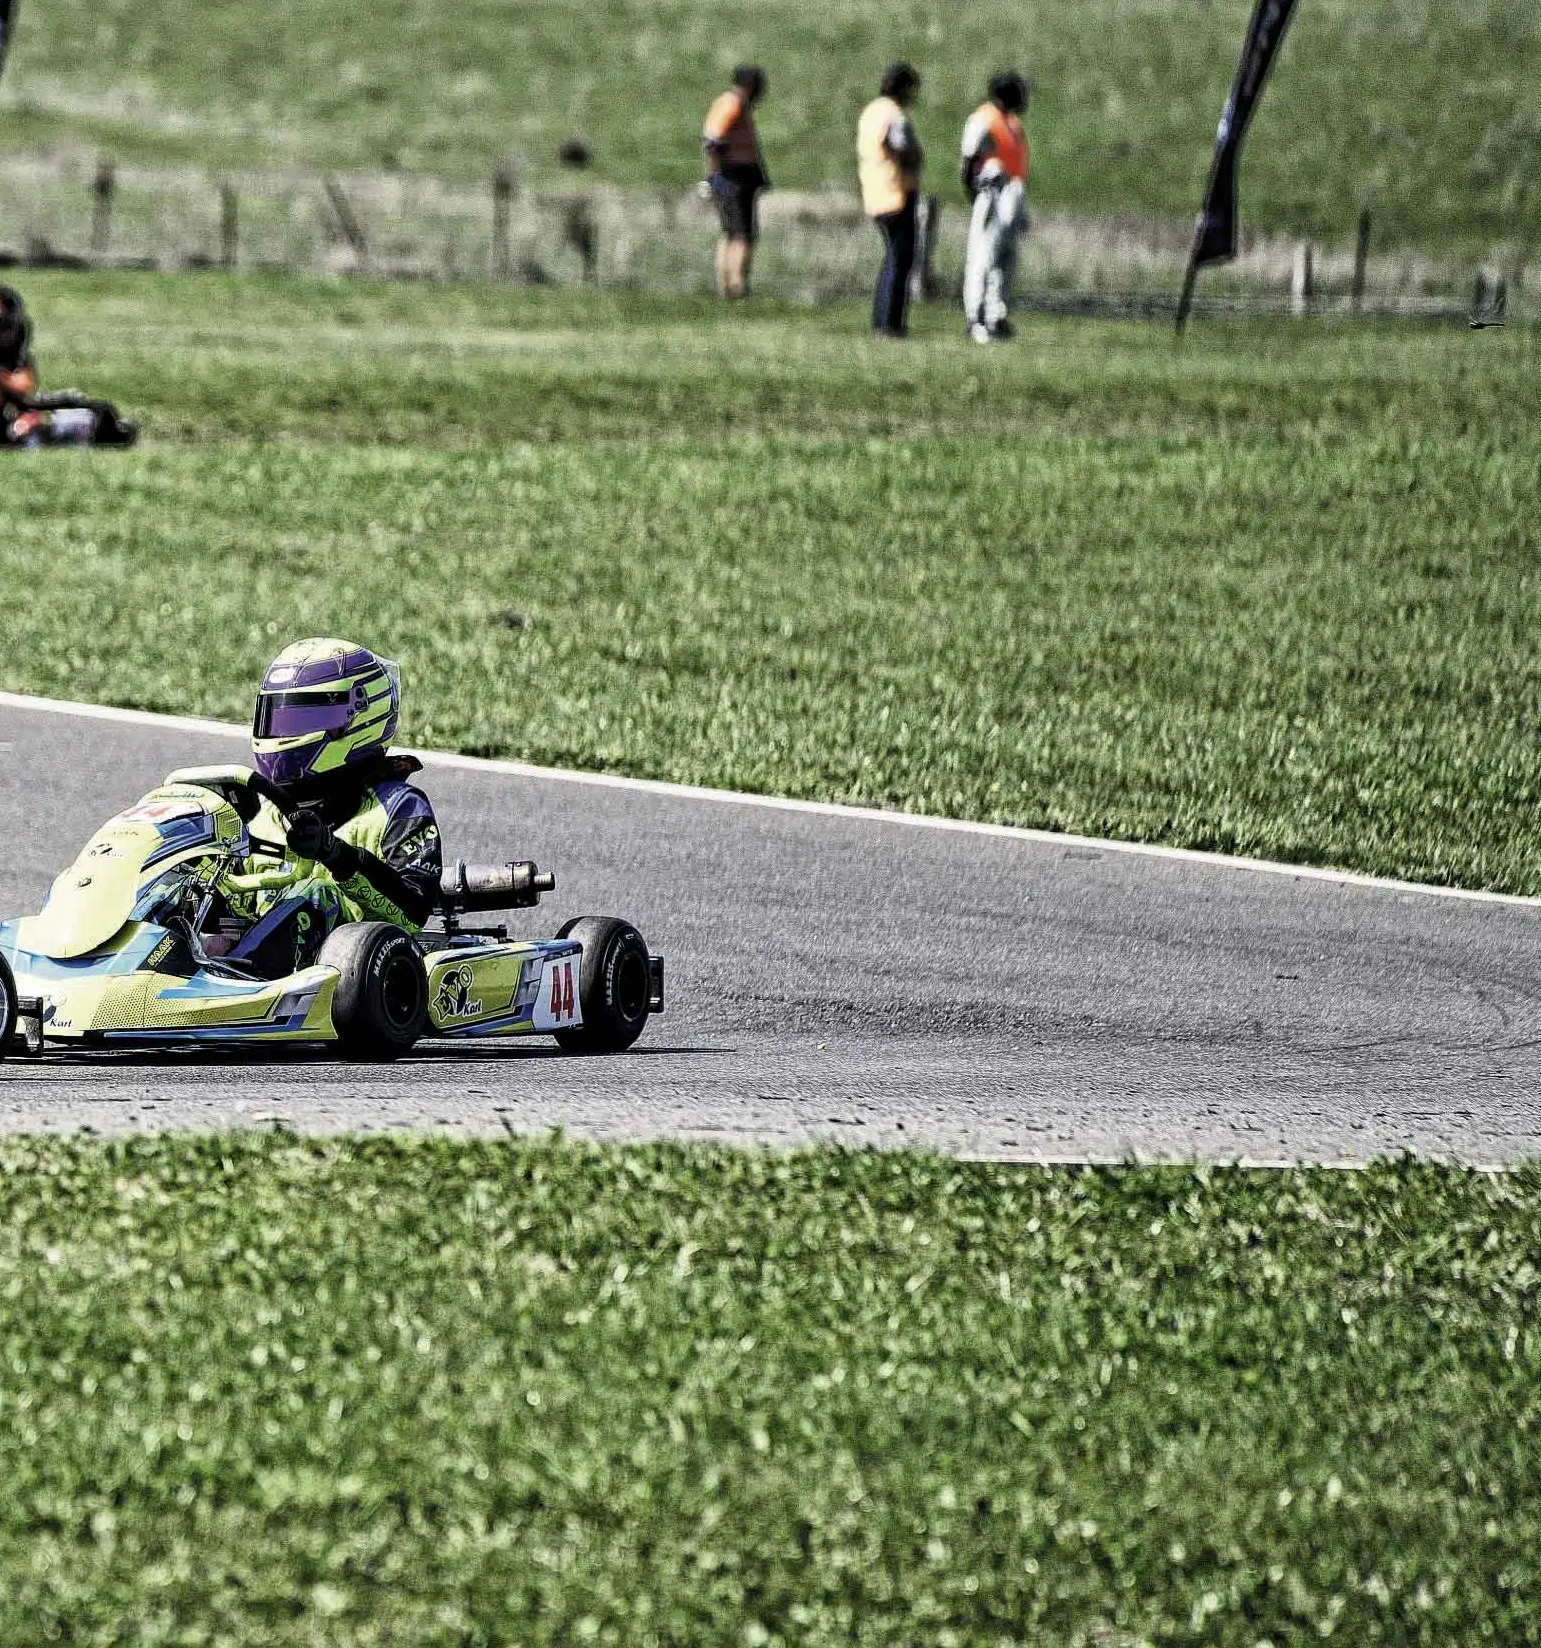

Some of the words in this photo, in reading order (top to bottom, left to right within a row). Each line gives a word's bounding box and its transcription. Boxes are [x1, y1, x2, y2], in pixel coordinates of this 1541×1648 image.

[550, 962, 575, 1022] 44
[462, 999, 483, 1018] Kart
[49, 1018, 73, 1028] Kart
